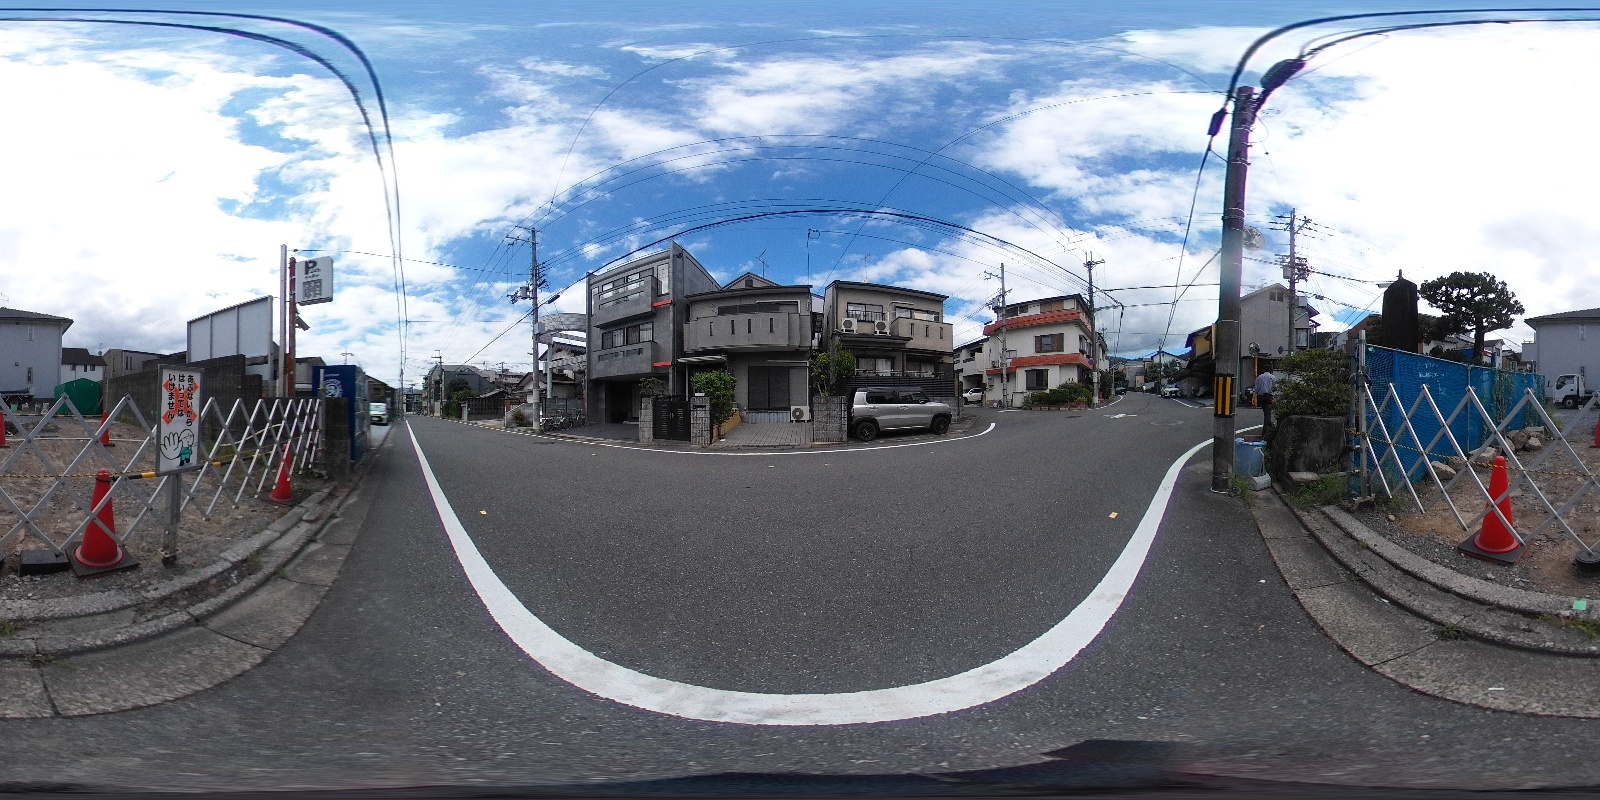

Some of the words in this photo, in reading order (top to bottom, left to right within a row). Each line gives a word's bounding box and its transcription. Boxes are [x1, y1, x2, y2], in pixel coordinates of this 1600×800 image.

[304, 260, 317, 274] P
[168, 374, 176, 419] いけません
[178, 374, 186, 417] はいっては
[186, 374, 194, 426] あぶないから
